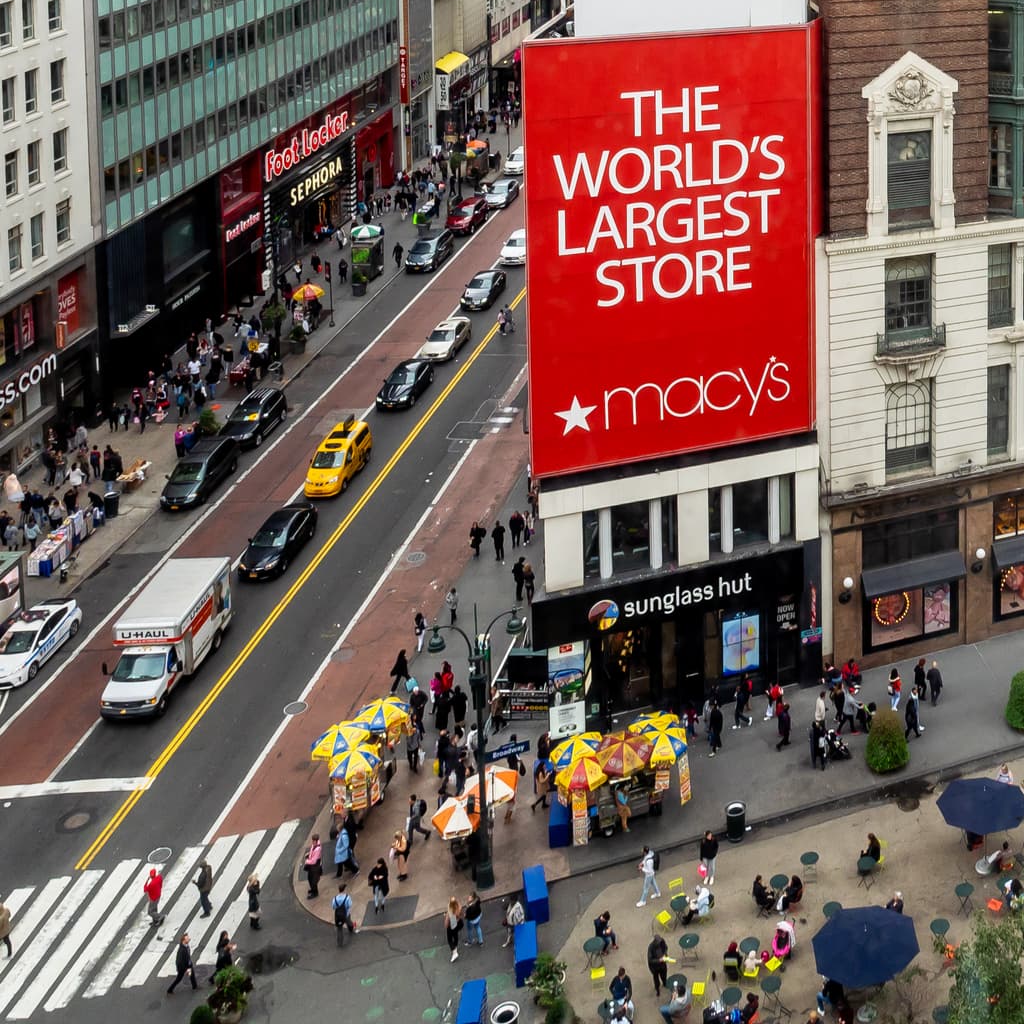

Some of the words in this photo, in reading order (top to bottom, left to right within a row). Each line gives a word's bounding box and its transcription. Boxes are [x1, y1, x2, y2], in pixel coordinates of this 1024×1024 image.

[620, 85, 721, 137] THE
[265, 136, 300, 182] Foot
[302, 111, 349, 156] Locker
[552, 135, 786, 200] WORLD'S
[290, 156, 343, 206] SEPHORA
[557, 188, 781, 257] LARGEST
[595, 245, 752, 307] STORE
[624, 583, 714, 618] sunglass
[718, 572, 753, 597] hut
[776, 612, 796, 623] OPEN
[777, 603, 795, 614] NOW
[121, 630, 169, 639] U-HAUL
[492, 744, 526, 759] Broadway
